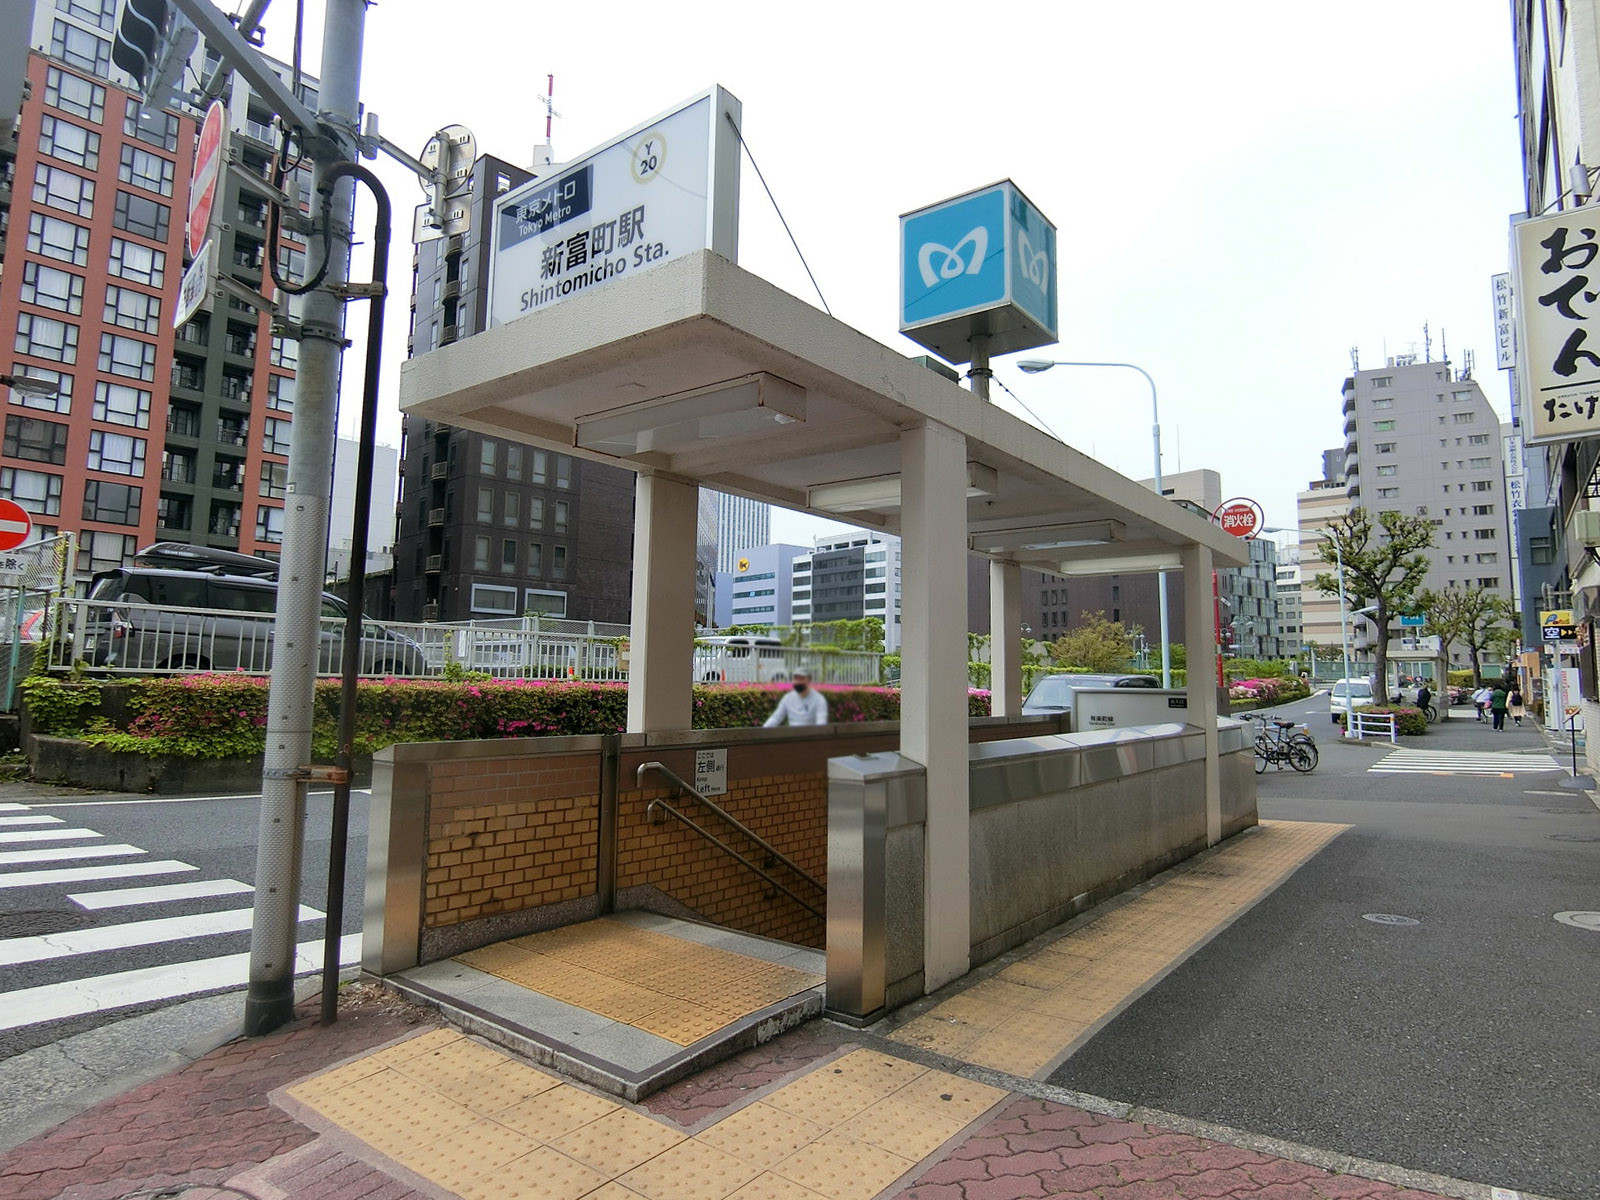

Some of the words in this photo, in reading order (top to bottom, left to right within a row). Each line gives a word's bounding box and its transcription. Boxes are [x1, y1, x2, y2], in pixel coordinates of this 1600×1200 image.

[644, 141, 654, 155] Y
[640, 155, 657, 175] 20
[516, 180, 576, 224] 東京メトロ
[519, 219, 544, 237] Tokyo
[544, 205, 571, 225] Metro
[540, 205, 645, 280] 新富町駅
[520, 258, 627, 312] Shintomicho
[633, 242, 670, 268] Sta.
[1538, 227, 1600, 377] おでん
[1223, 513, 1254, 529] 消火栓
[696, 784, 710, 793] Left
